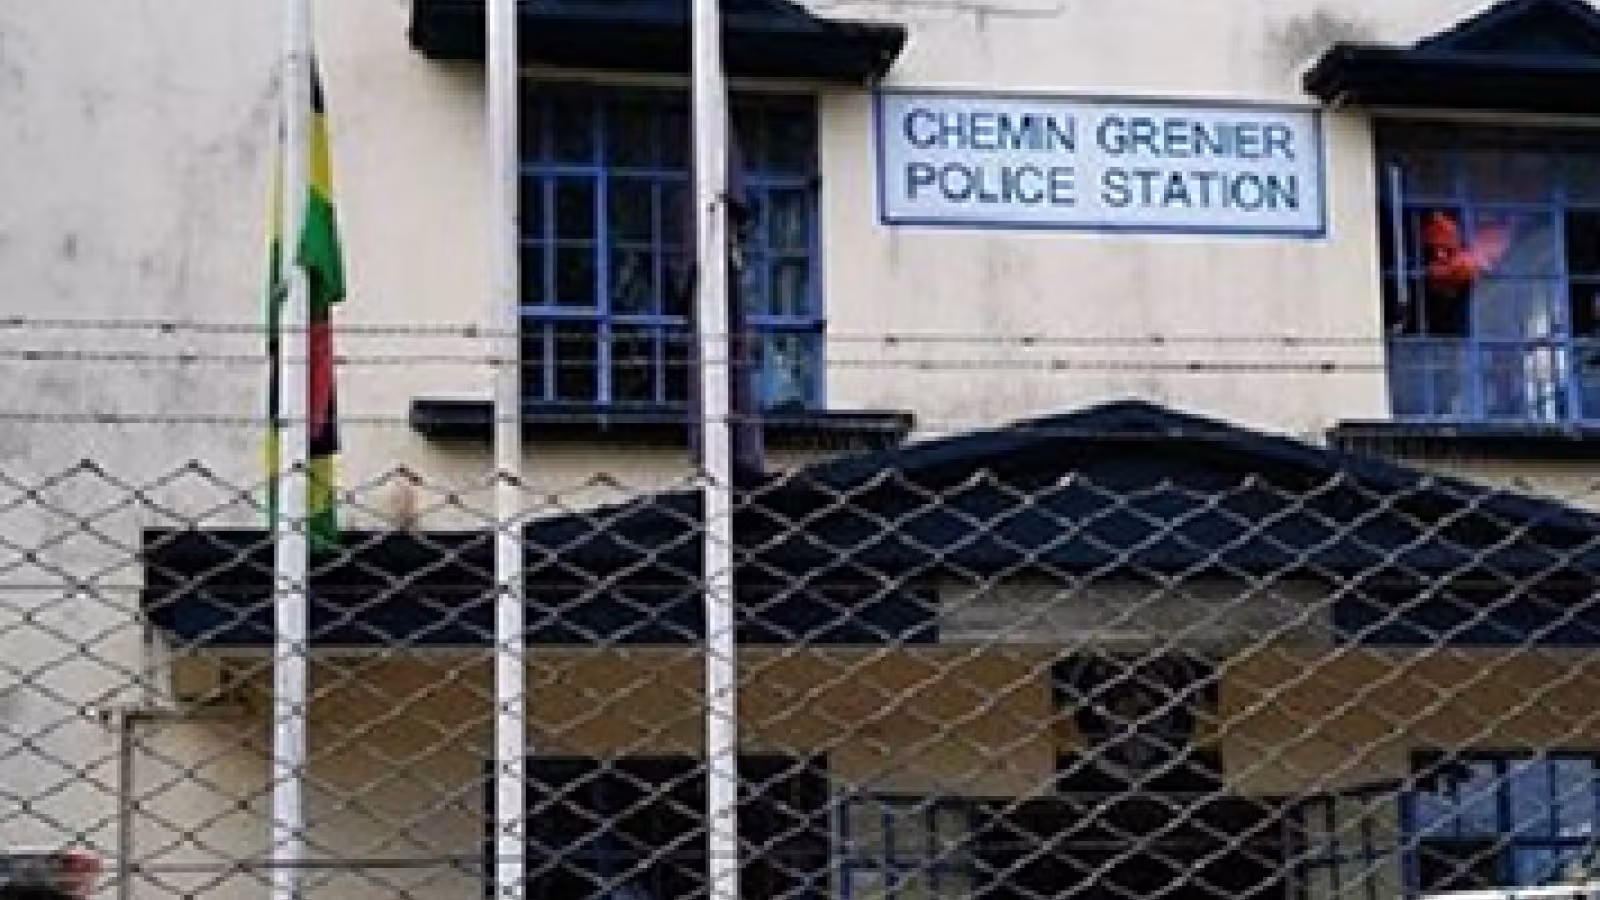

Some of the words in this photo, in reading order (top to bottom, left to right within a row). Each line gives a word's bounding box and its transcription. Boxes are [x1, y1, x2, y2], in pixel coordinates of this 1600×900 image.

[904, 107, 1075, 150] CHEMIN
[1097, 116, 1295, 159] GRENIER
[907, 162, 1075, 204] POLICE
[1100, 167, 1299, 211] STATION
